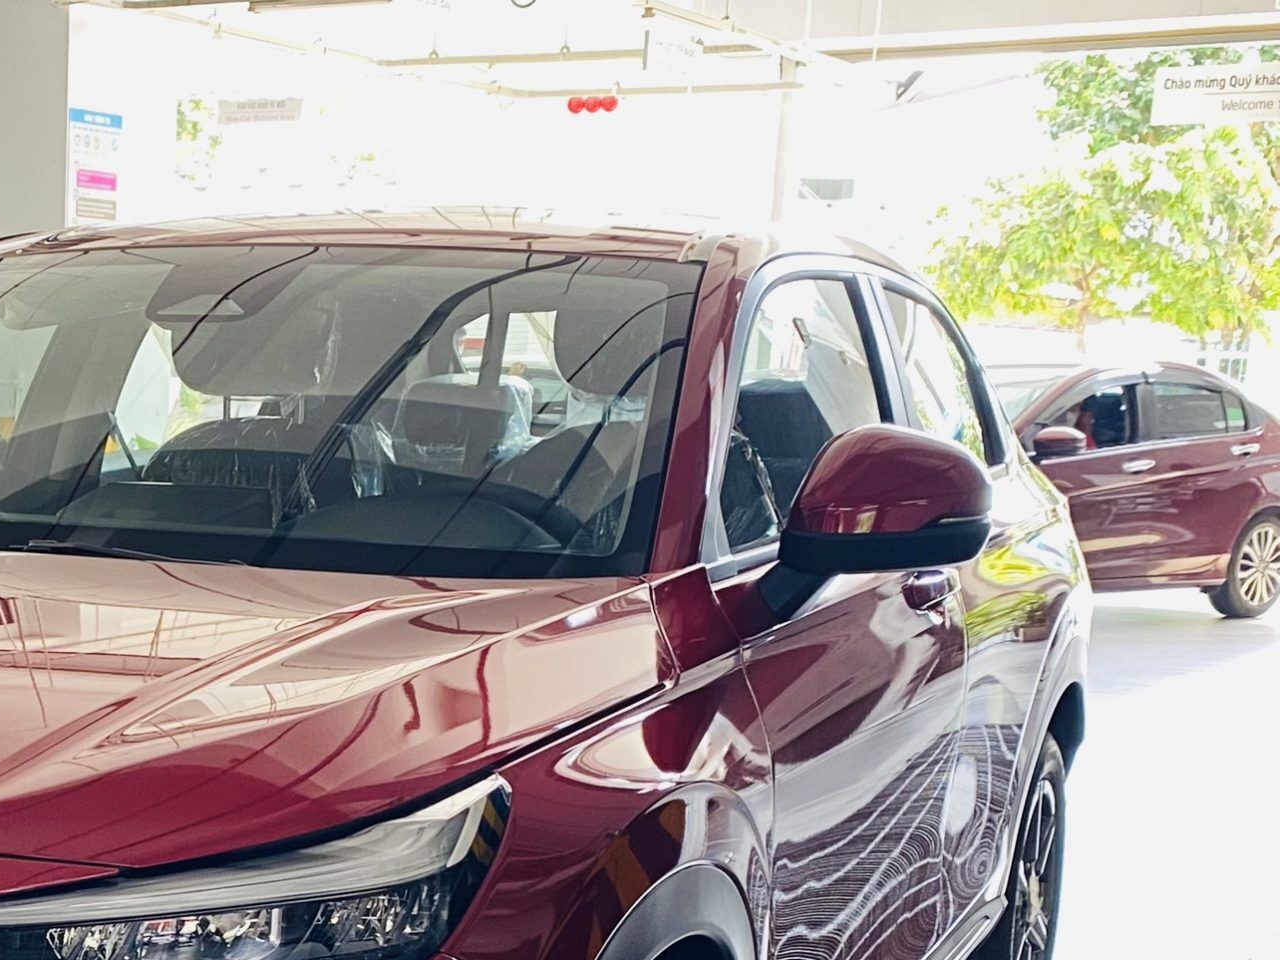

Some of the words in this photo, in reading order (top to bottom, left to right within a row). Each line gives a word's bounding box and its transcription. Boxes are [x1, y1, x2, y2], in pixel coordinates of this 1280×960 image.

[1163, 76, 1191, 90] Chào
[1194, 76, 1226, 91] mừng
[1229, 74, 1252, 89] Quý
[1221, 99, 1274, 111] Welcome
